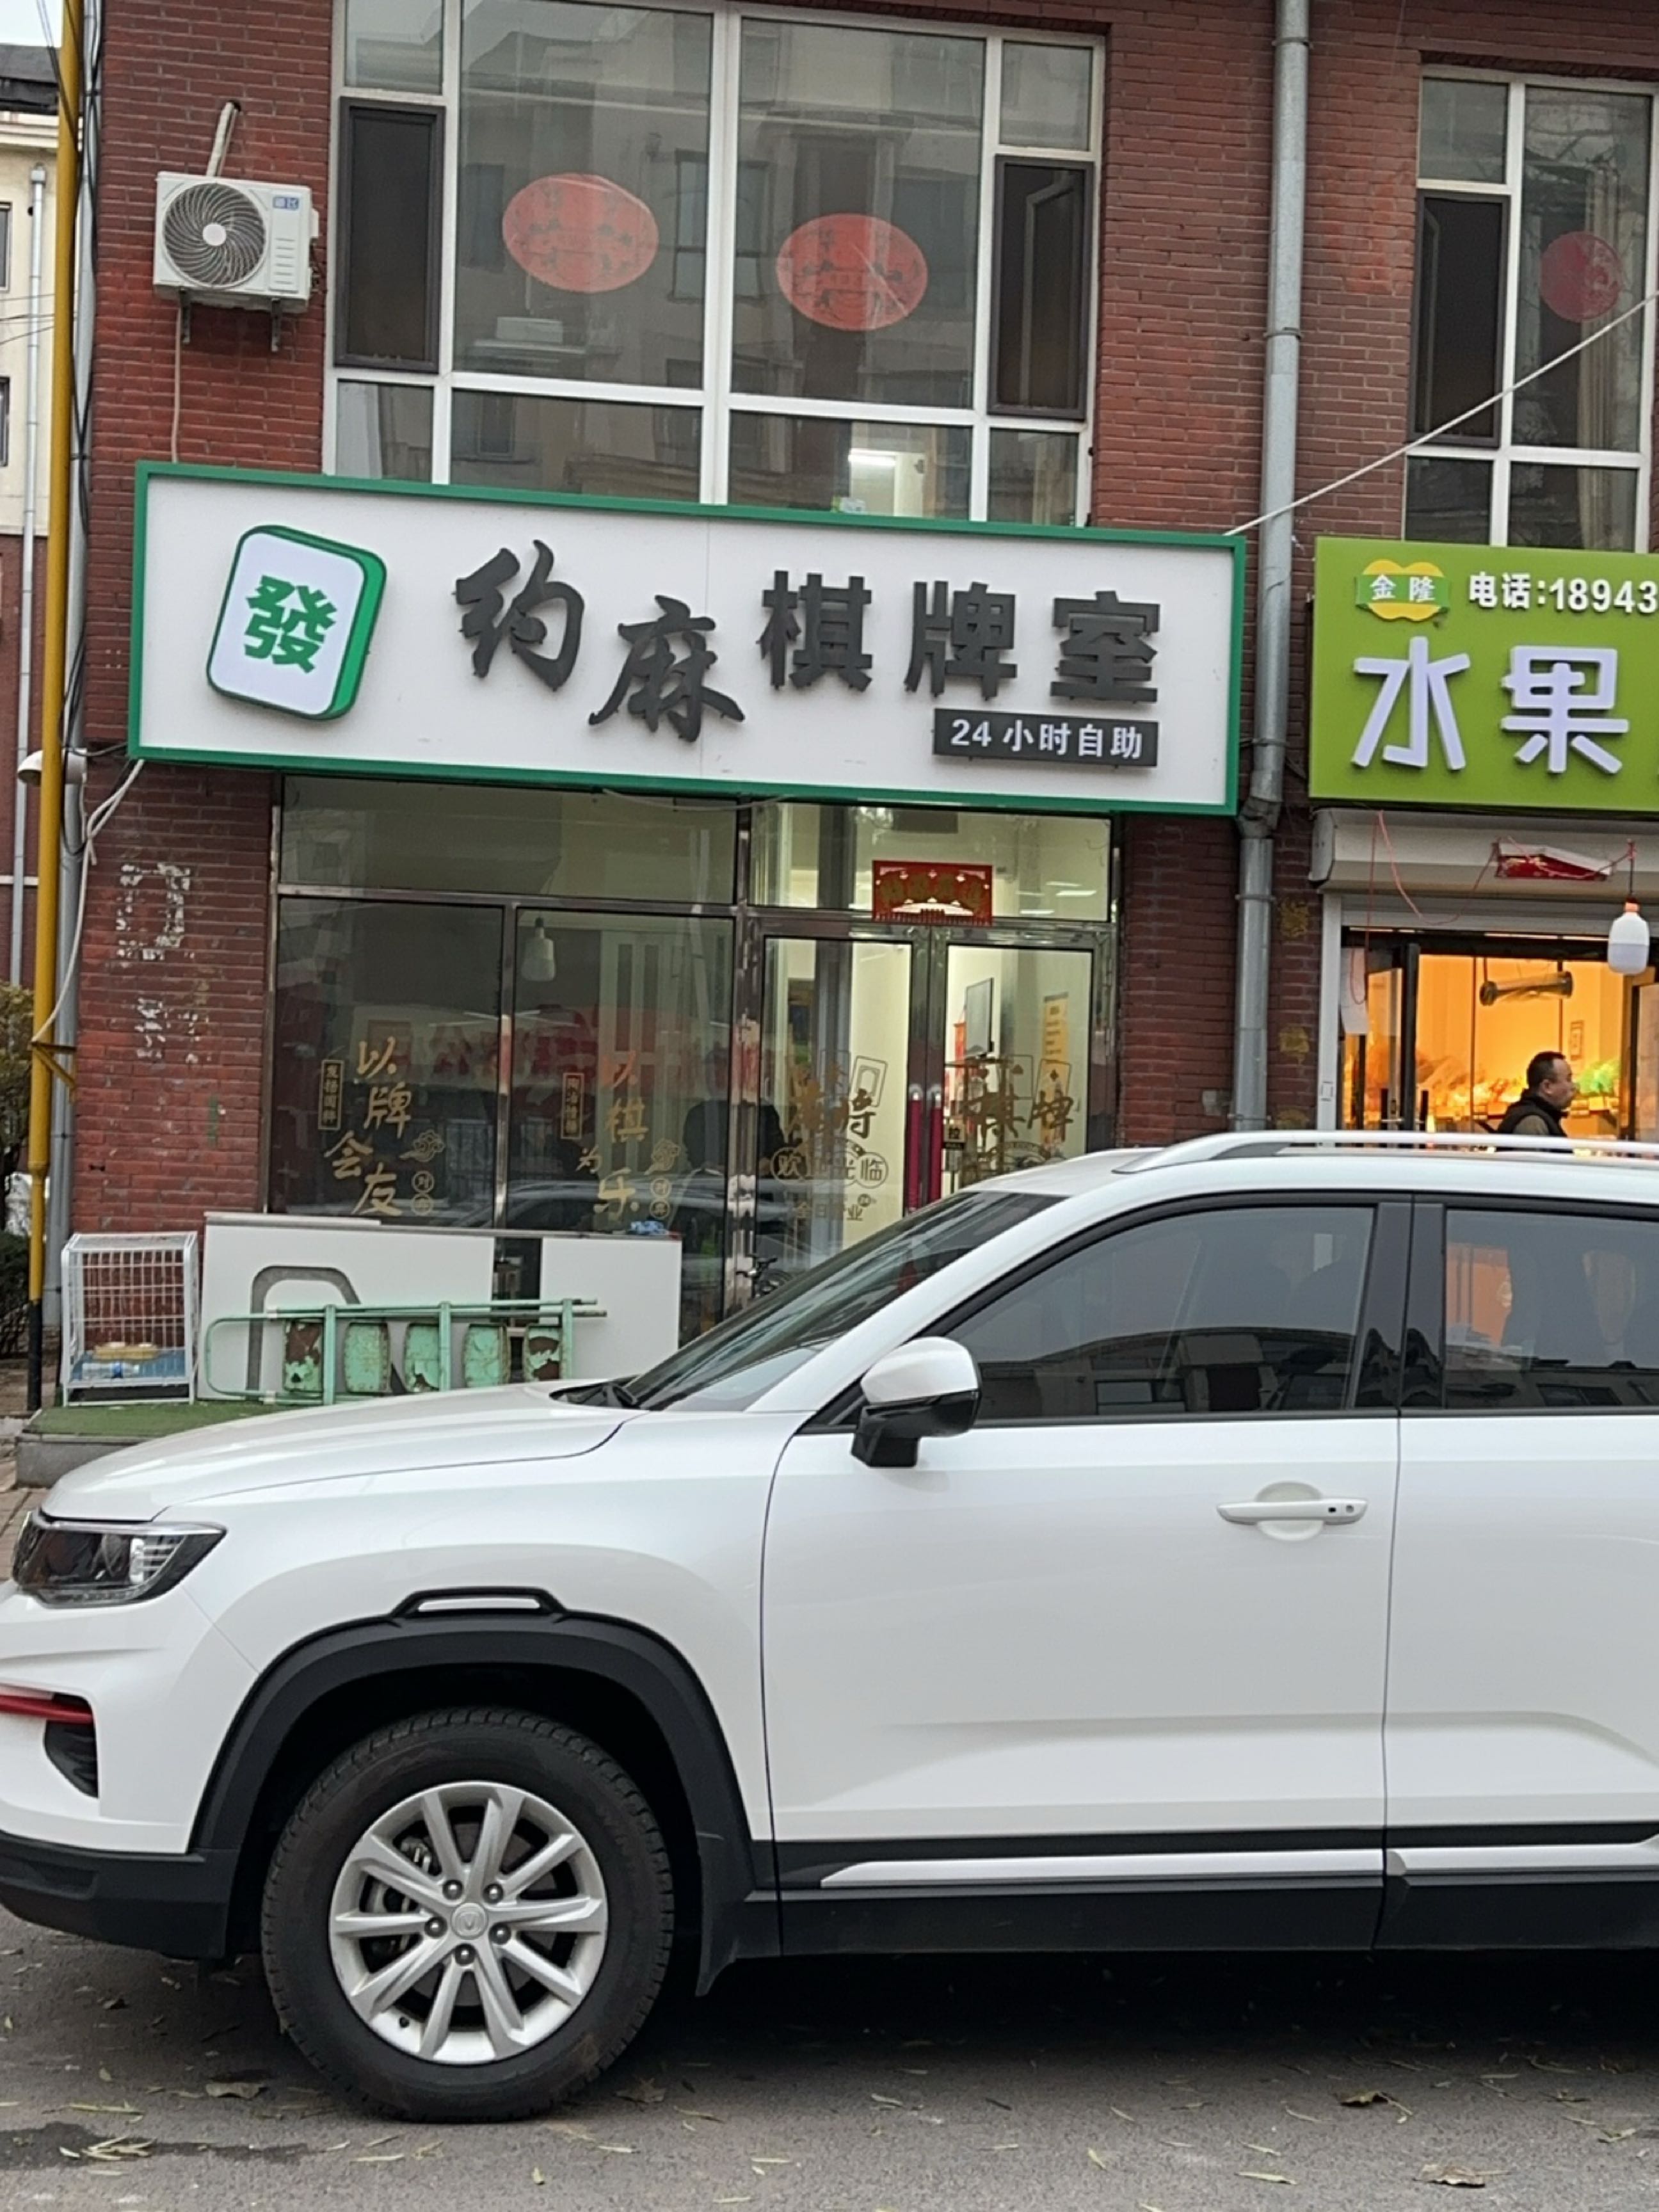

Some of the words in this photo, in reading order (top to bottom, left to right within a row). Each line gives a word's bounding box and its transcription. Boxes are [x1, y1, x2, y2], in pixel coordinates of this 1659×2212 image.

[244, 575, 338, 674] 發
[454, 539, 1160, 744] 约麻棋牌室
[1369, 573, 1436, 602] 金隆
[950, 718, 1143, 760] 24小时自助
[1352, 636, 1630, 774] 水果
[323, 1036, 412, 1216] 以牌会友
